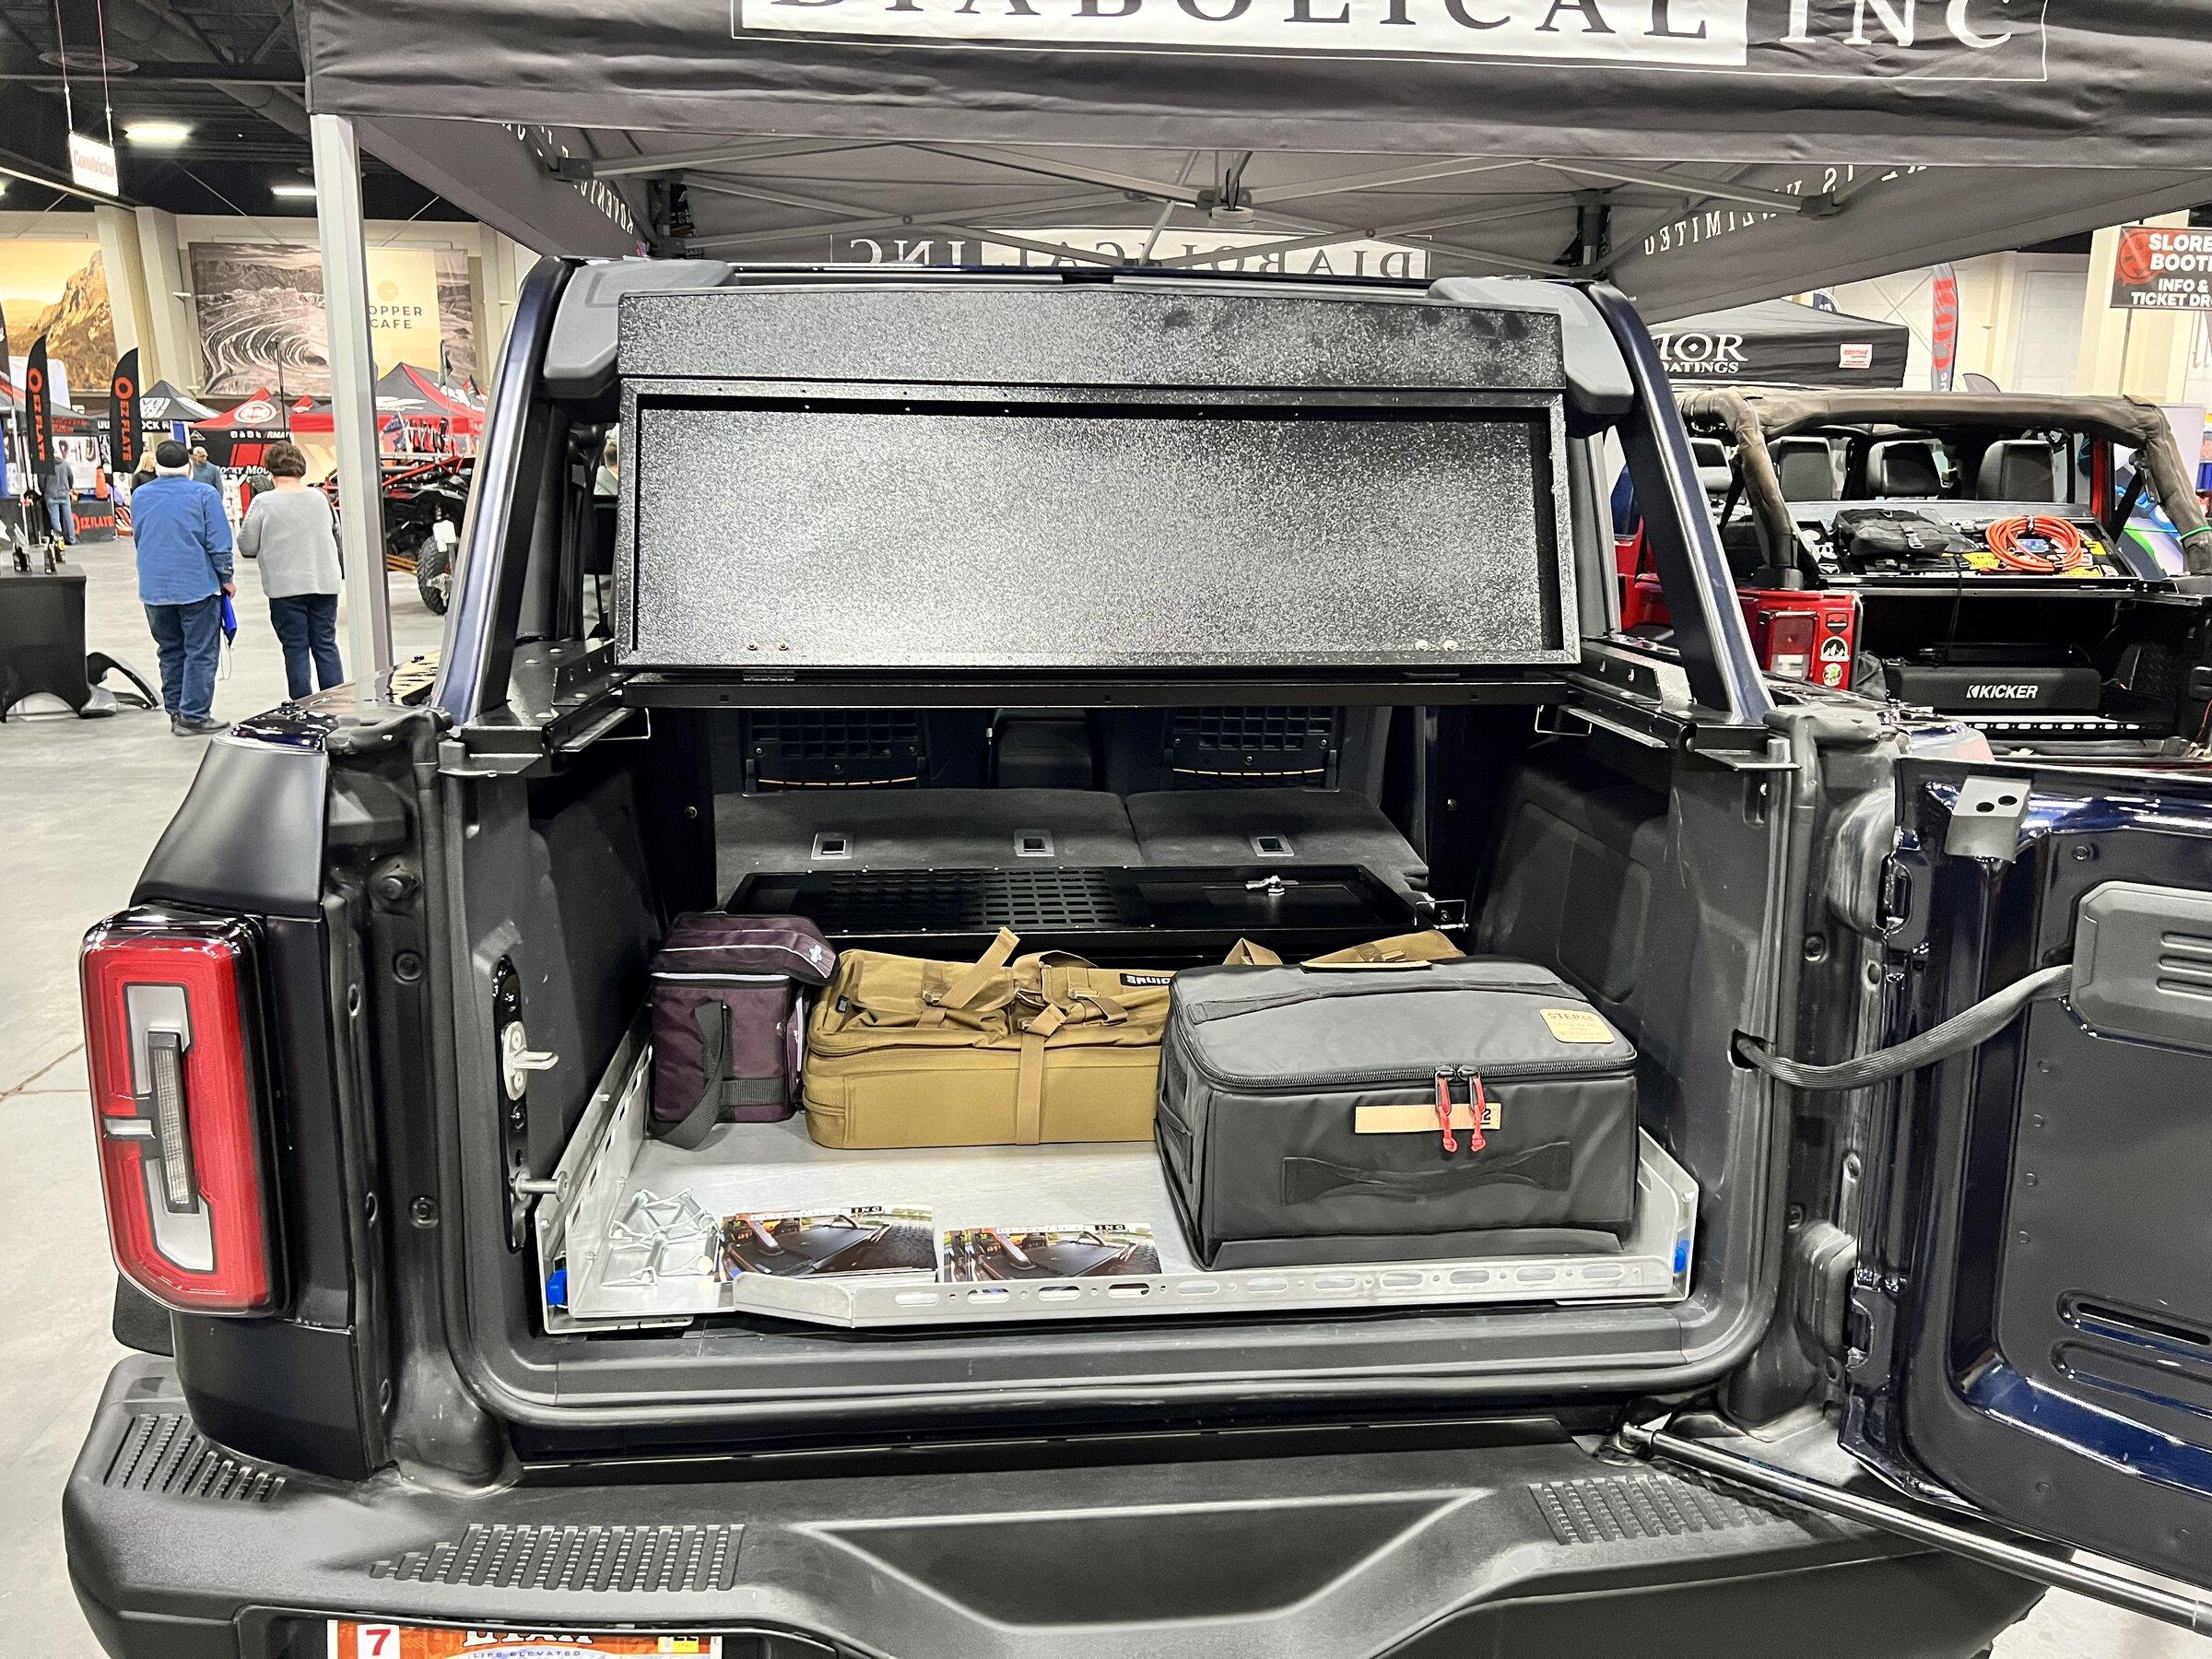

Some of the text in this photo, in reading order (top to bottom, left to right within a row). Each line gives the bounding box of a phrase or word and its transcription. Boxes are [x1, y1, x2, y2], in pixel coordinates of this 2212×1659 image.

[1779, 0, 2013, 49] INC
[2158, 277, 2208, 293] INFO &
[2131, 291, 2212, 308] TICKET DR
[368, 305, 422, 316] OPPER
[370, 318, 412, 329] CAFE
[1978, 684, 2039, 699] KICKER
[365, 1629, 391, 1656] 7
[509, 1650, 582, 1658] ELEVATED
